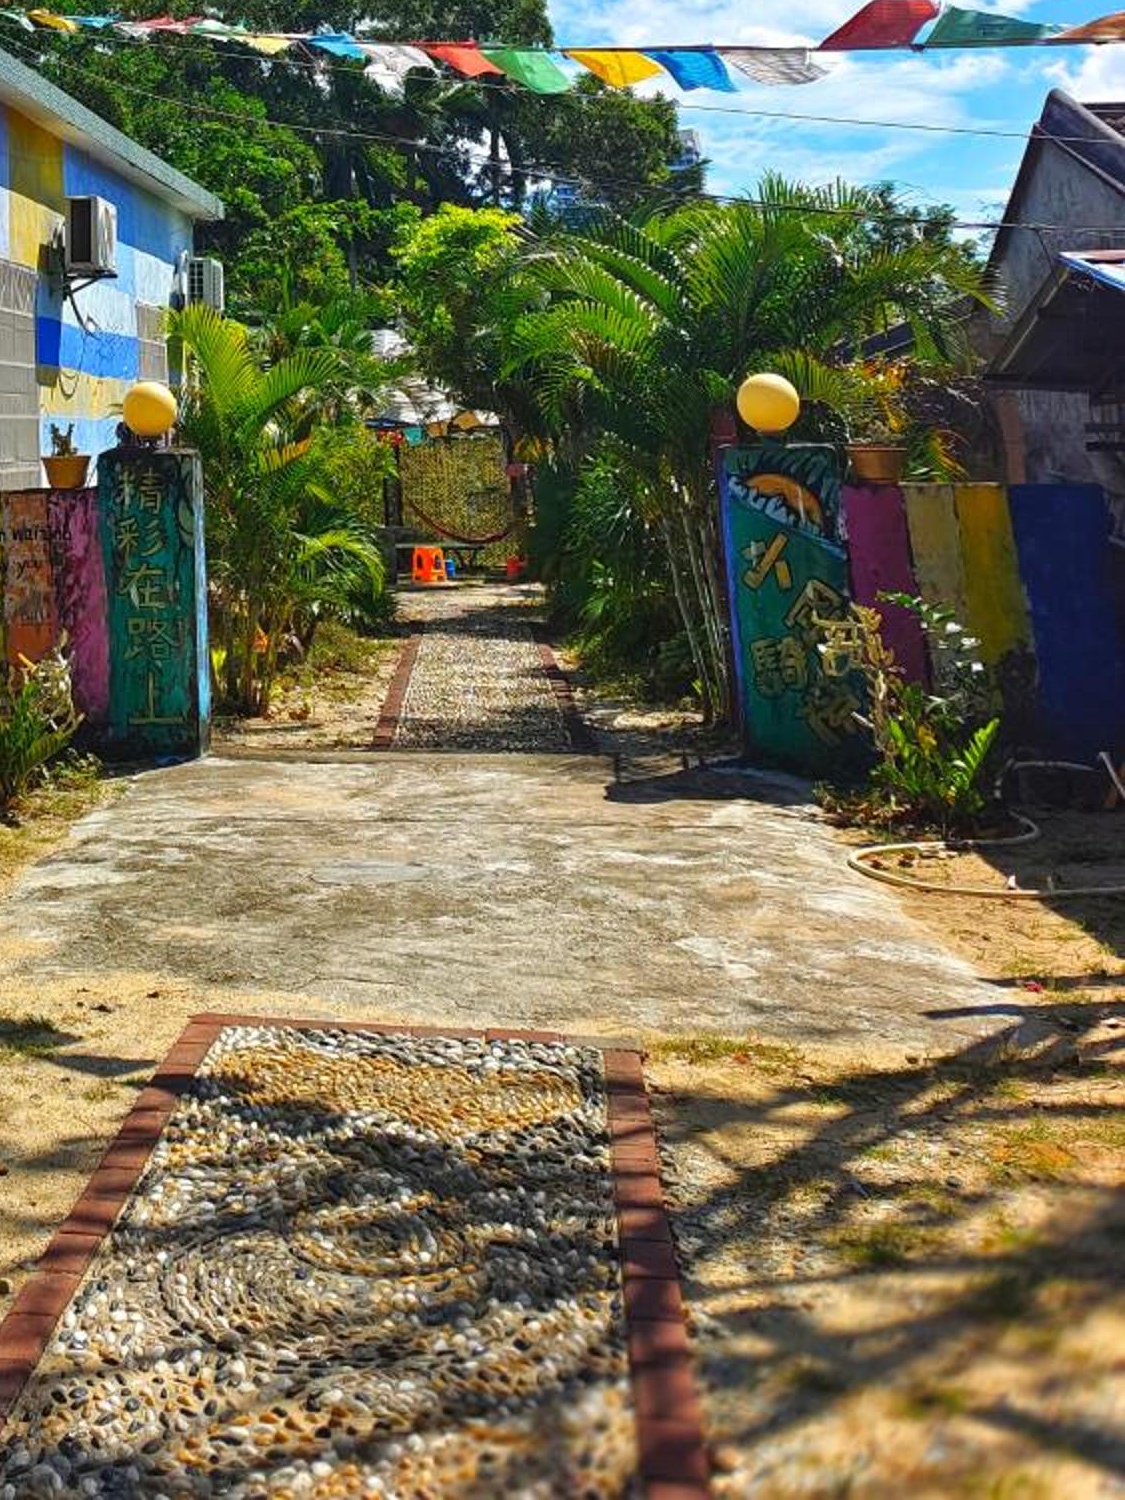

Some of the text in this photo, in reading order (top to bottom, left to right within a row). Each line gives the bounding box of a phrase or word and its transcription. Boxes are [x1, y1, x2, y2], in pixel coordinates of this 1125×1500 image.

[116, 464, 184, 725] 精彩在路上
